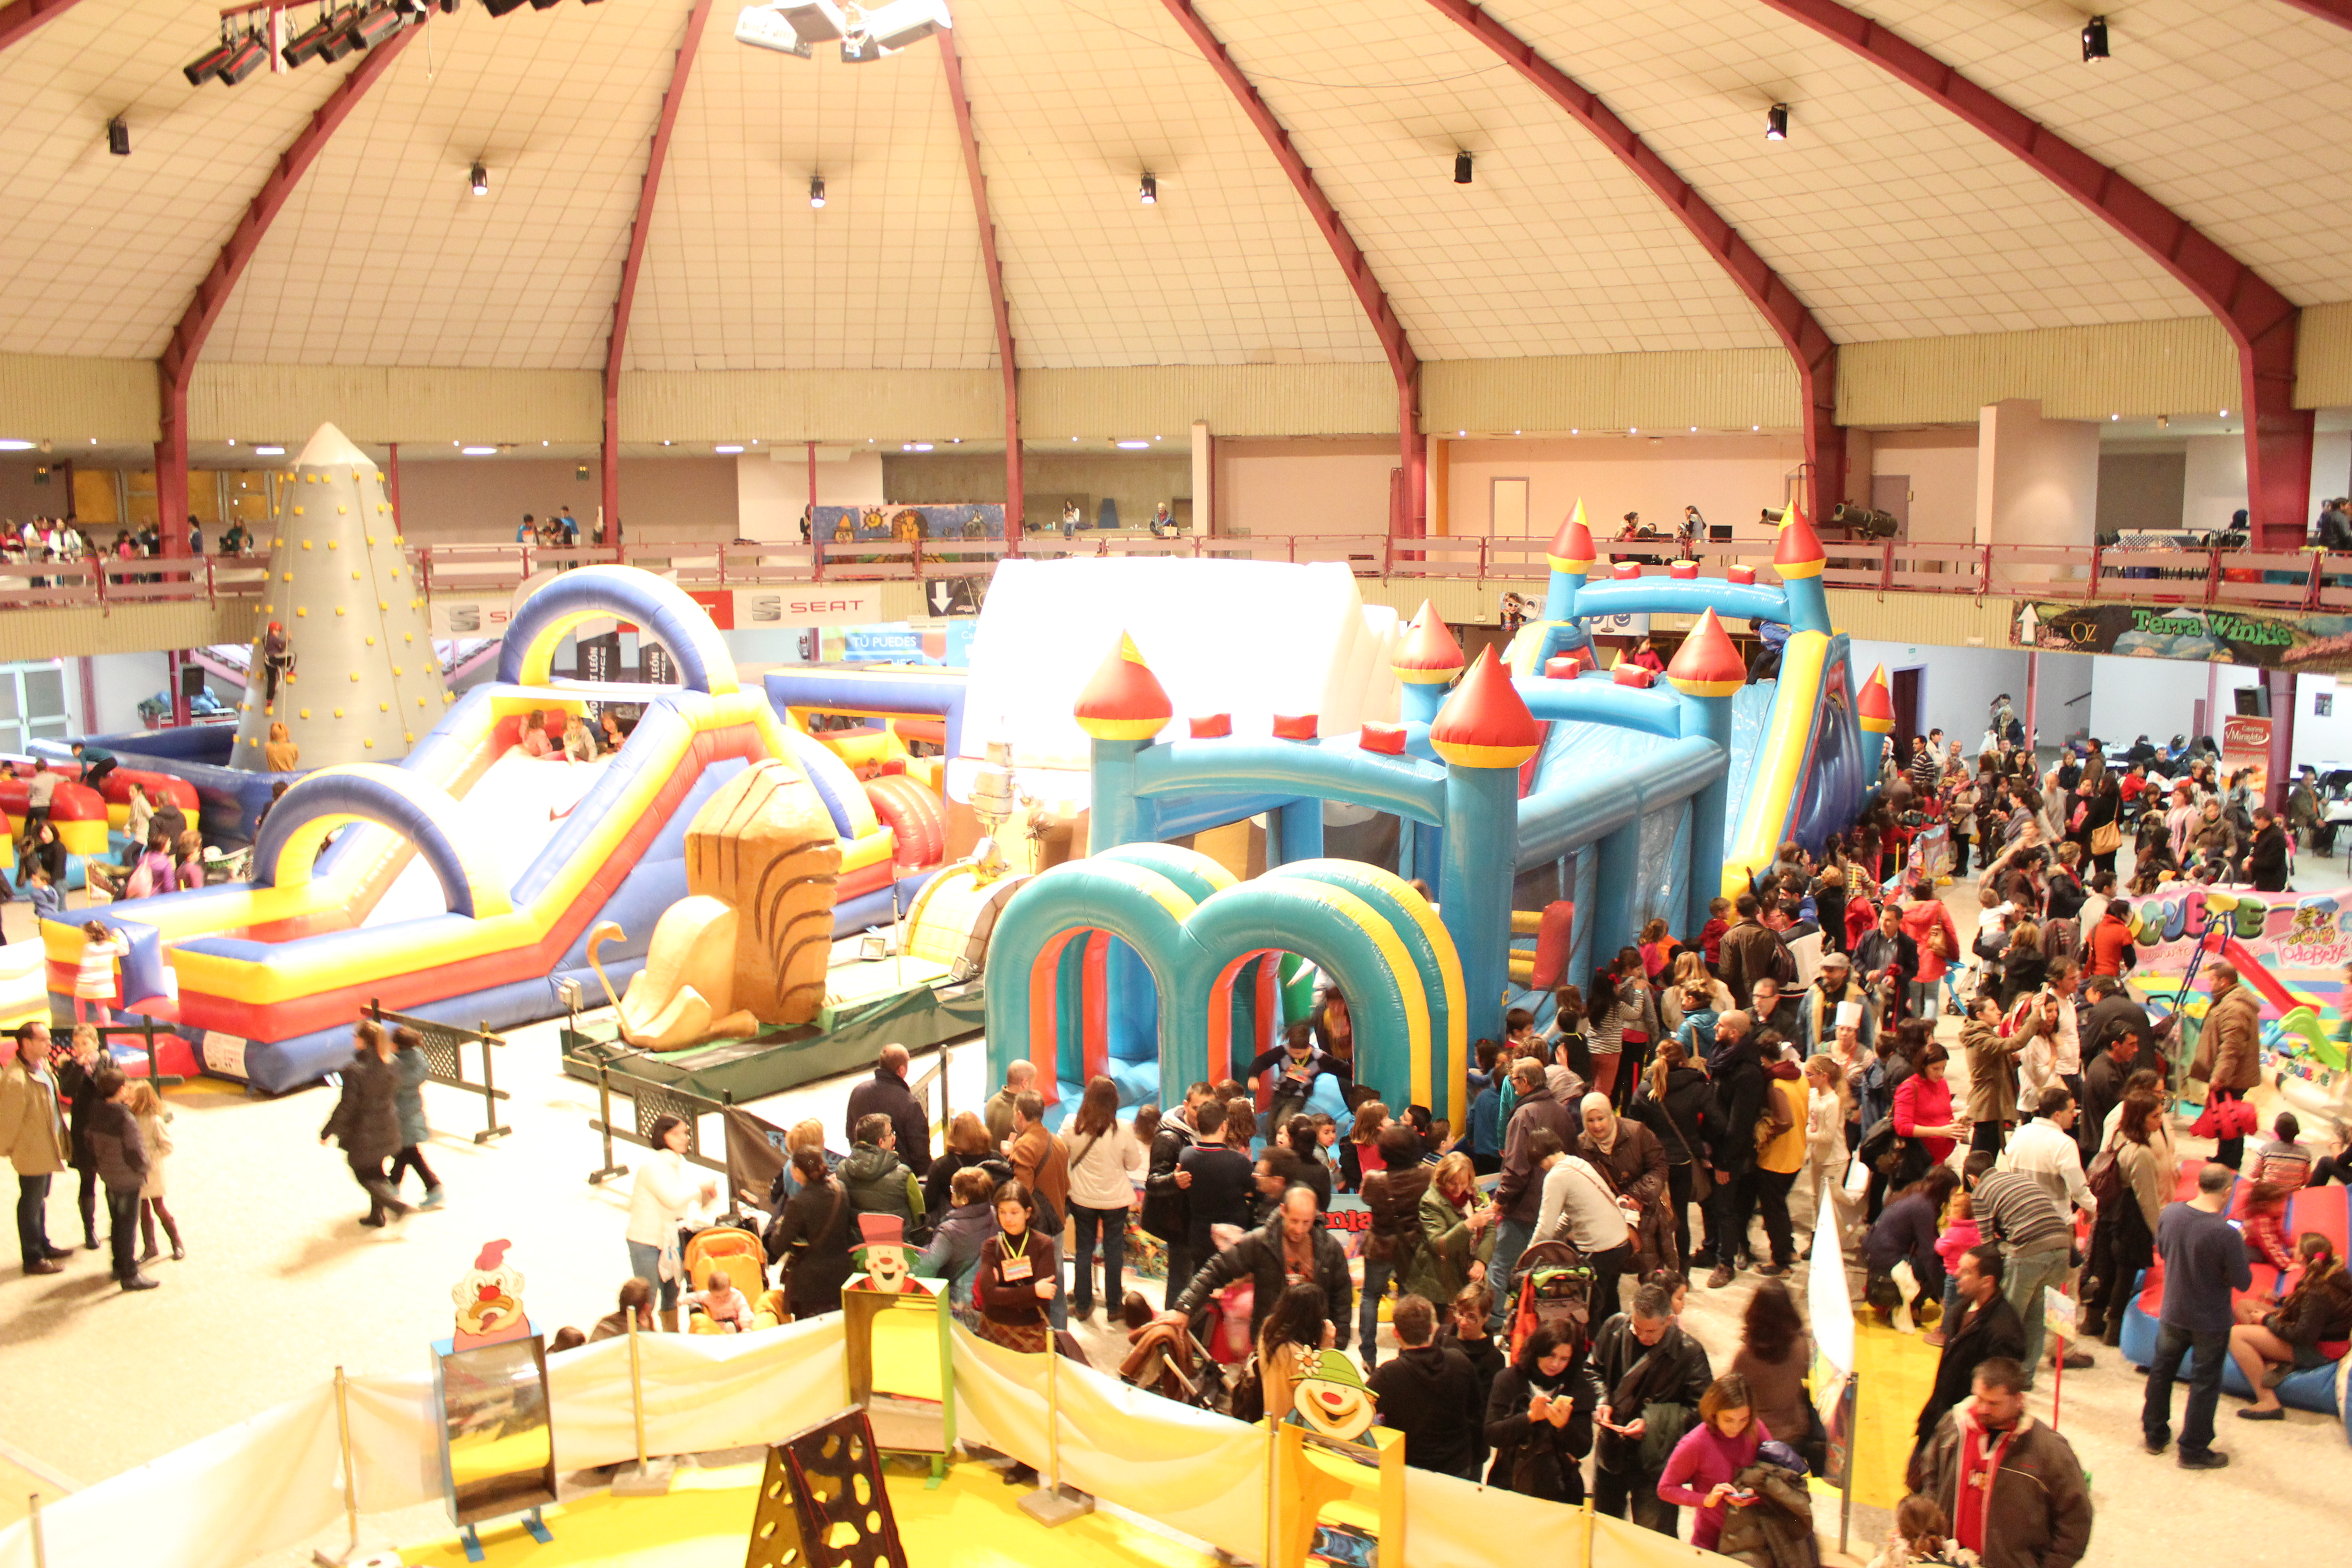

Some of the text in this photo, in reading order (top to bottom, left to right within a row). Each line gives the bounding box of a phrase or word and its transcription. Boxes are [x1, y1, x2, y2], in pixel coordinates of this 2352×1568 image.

[790, 600, 864, 613] SEAT
[2132, 610, 2293, 646] Terra Winkie
[852, 635, 916, 648] TÚ PUEDES
[588, 647, 598, 673] LEÓN
[649, 652, 660, 678] LEÓN
